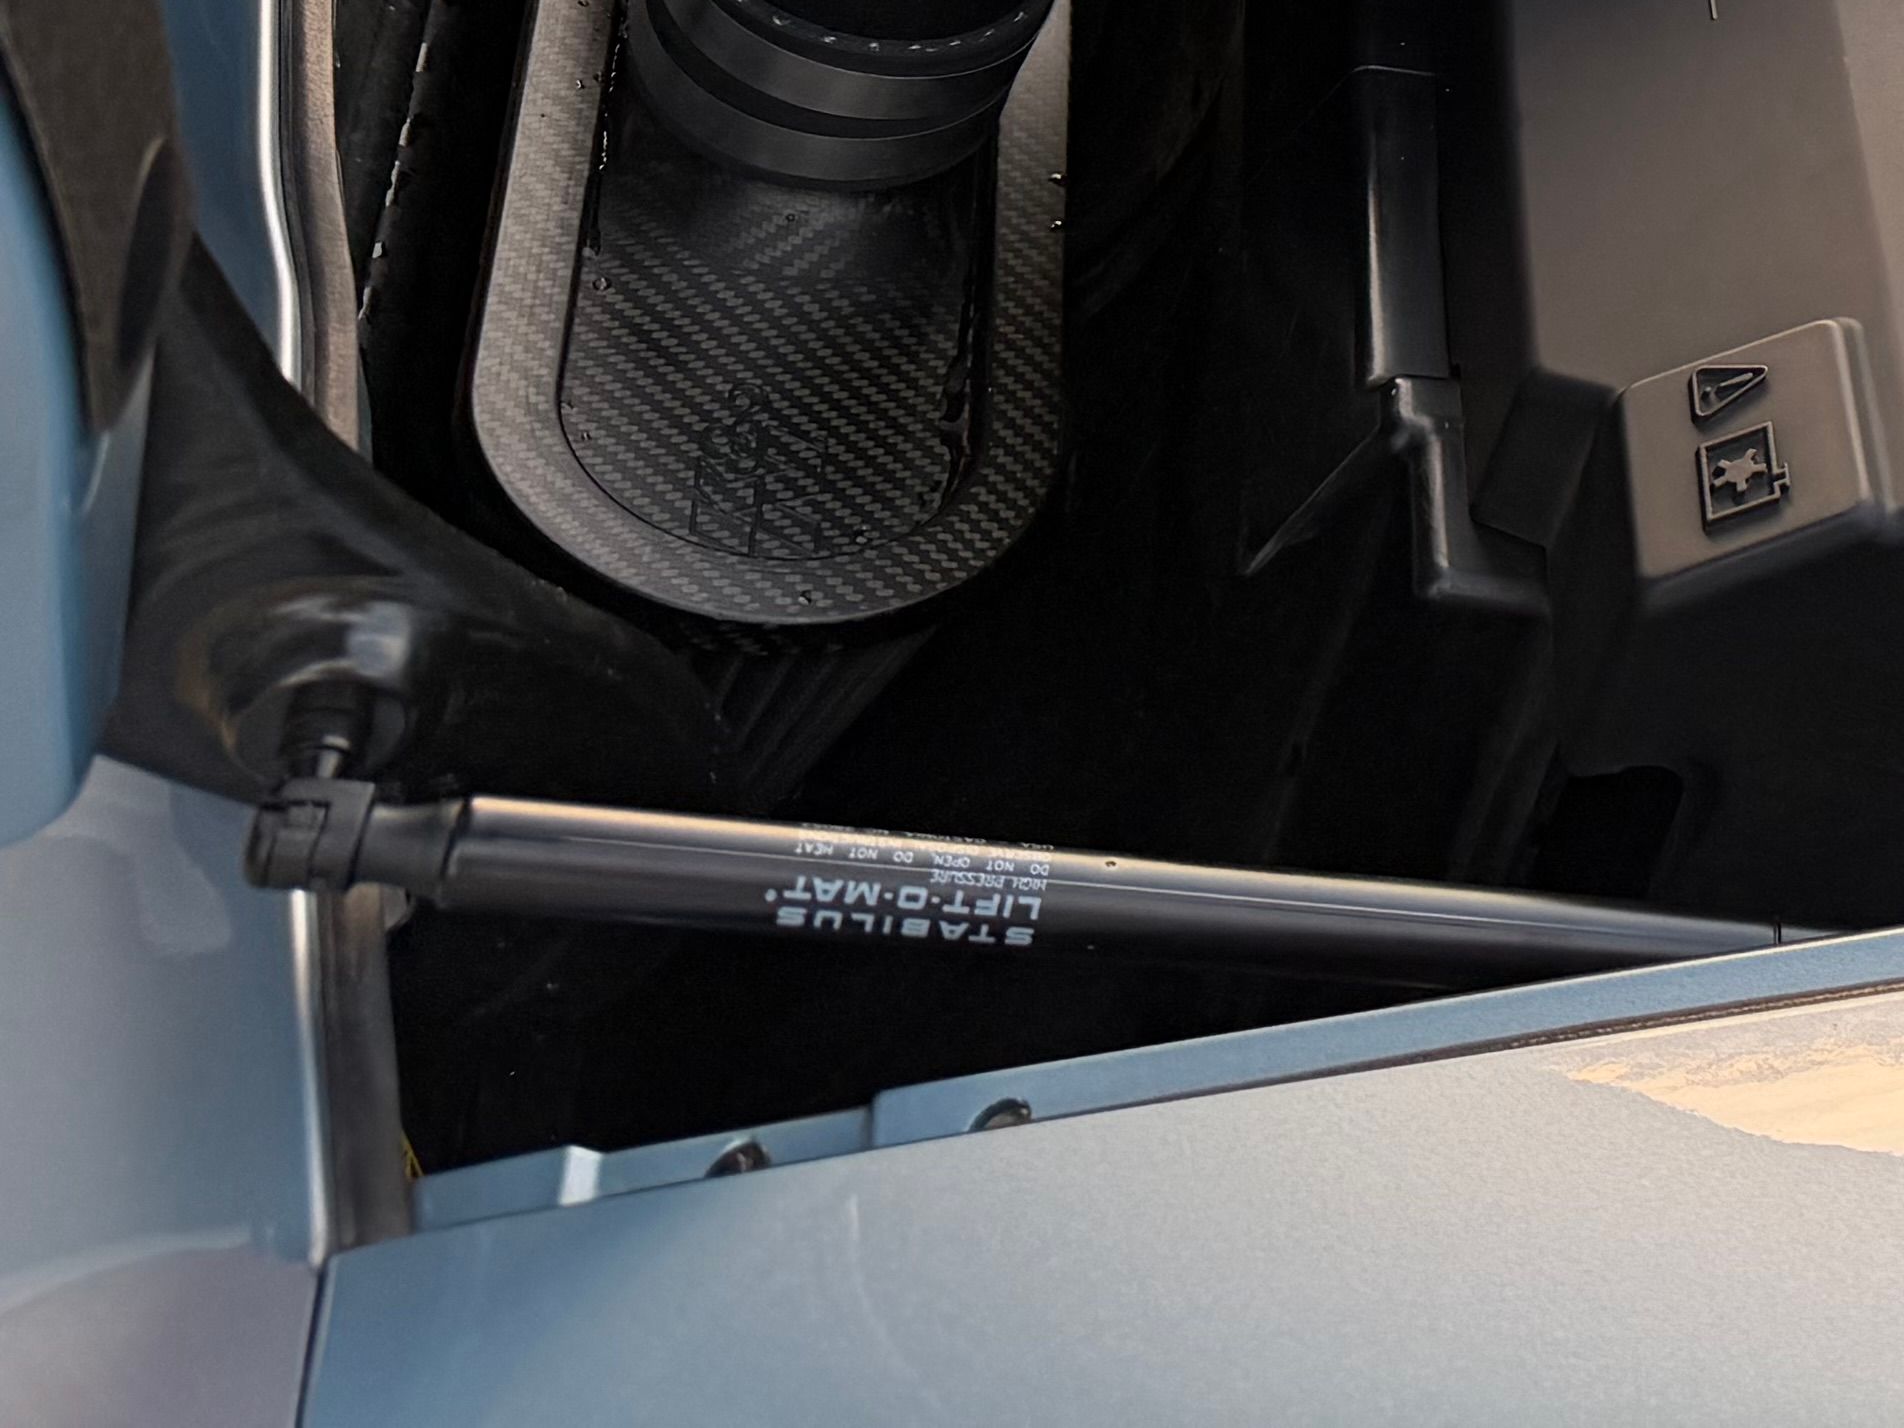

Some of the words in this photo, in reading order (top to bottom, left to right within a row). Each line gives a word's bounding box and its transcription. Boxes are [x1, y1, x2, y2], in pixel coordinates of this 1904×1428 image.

[794, 842, 835, 856] HEAT
[848, 846, 879, 860] NOT
[892, 850, 914, 864] DO
[985, 858, 1016, 873] NOT
[1030, 862, 1050, 877] DO
[929, 868, 1005, 890] PRESSURE
[775, 905, 1035, 946] STABILUS
